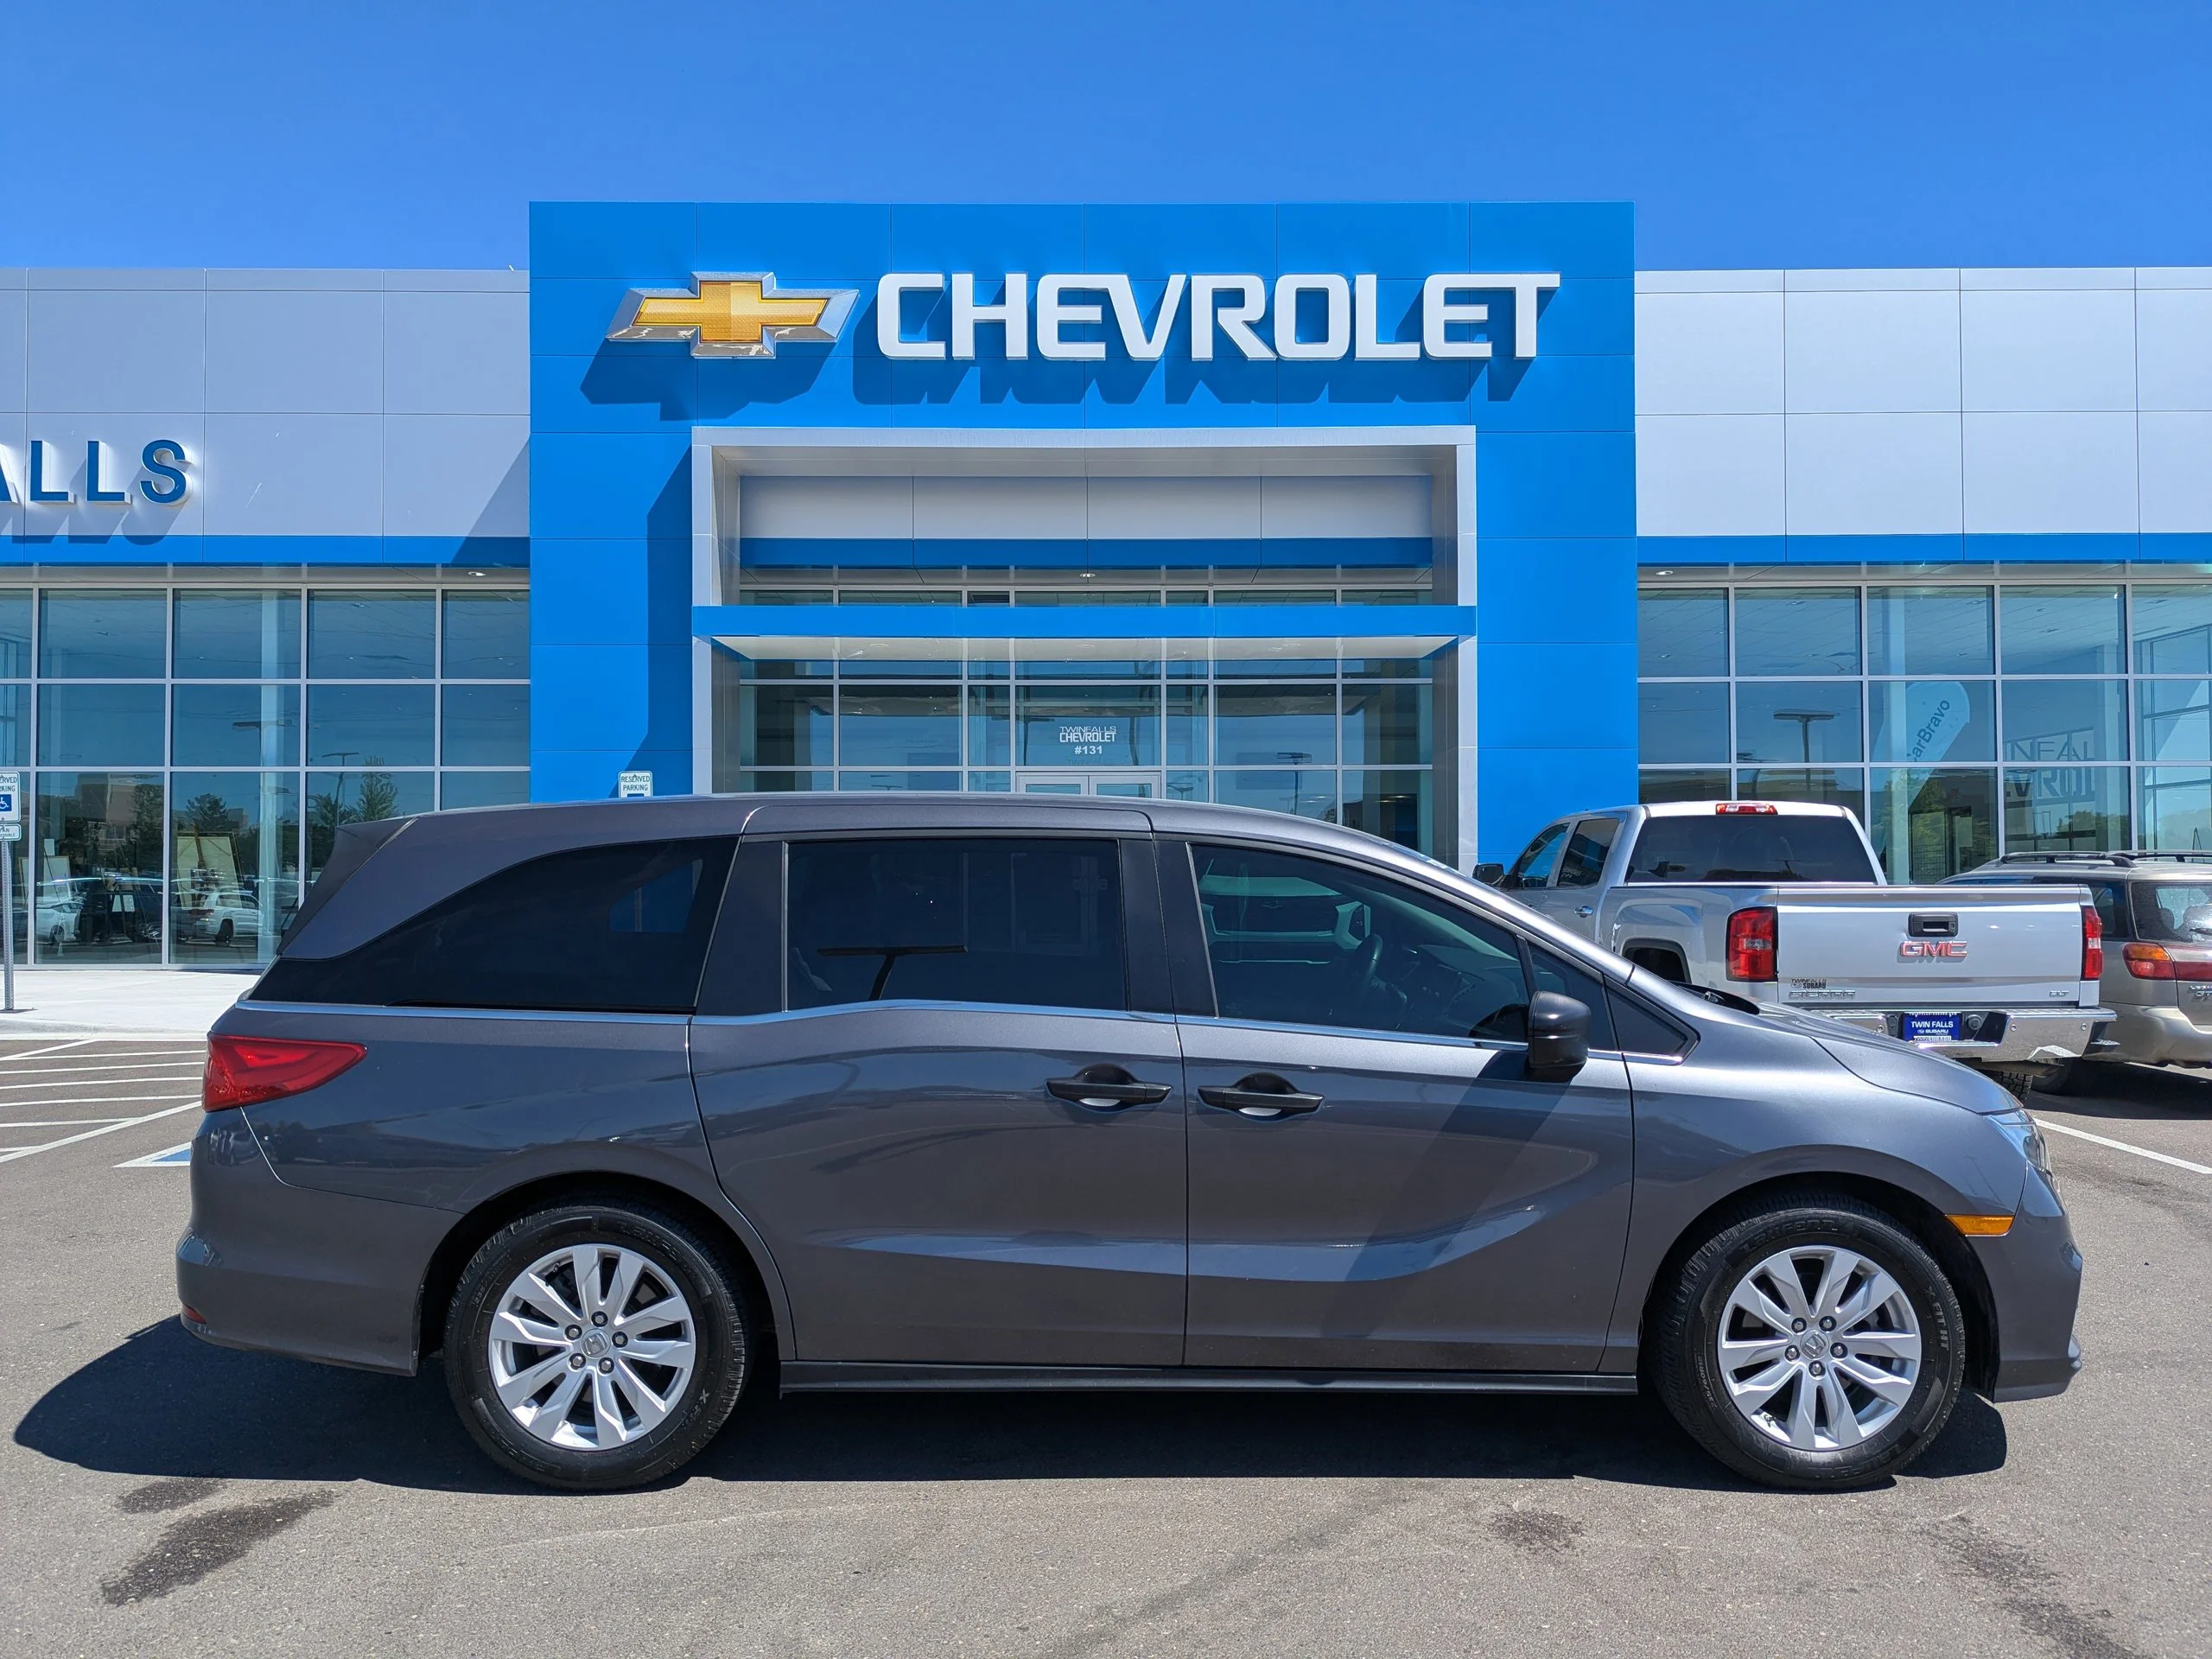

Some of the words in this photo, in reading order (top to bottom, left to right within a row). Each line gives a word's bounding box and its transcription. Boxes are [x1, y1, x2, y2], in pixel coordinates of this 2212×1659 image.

[876, 272, 1560, 361] CHEVROLET
[1059, 732, 1117, 743] CHEVROLET
[1906, 700, 1950, 762] arBravo
[1074, 745, 1103, 755] #131
[1901, 940, 1967, 957] GMC
